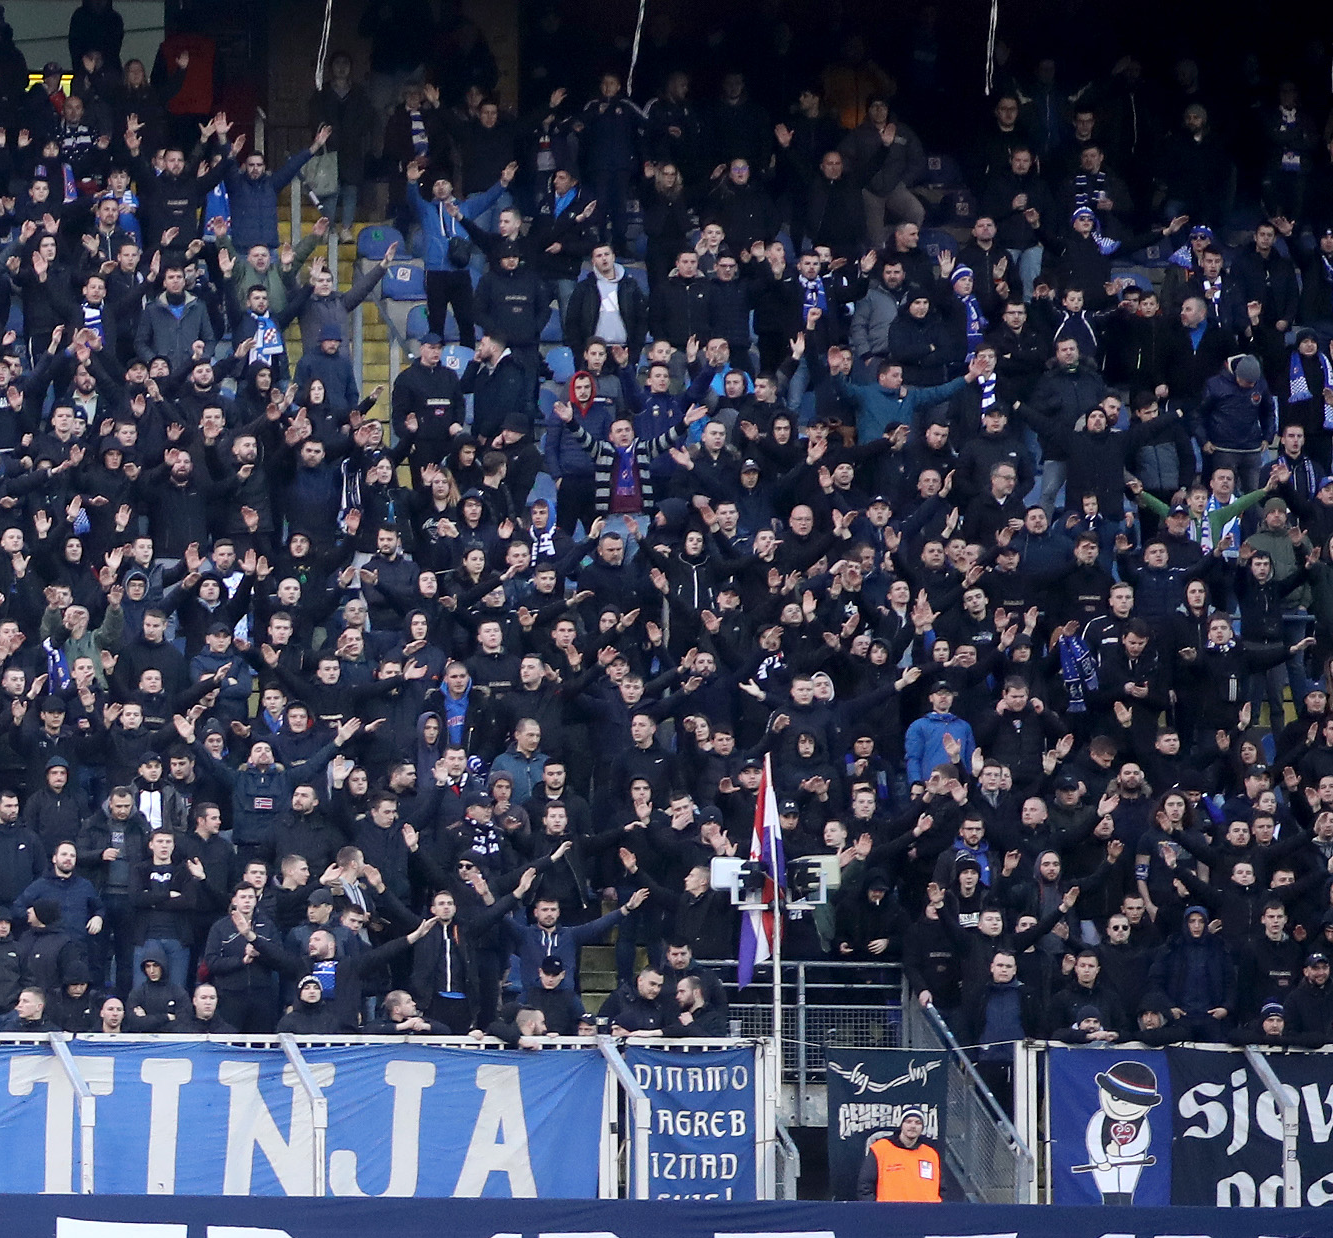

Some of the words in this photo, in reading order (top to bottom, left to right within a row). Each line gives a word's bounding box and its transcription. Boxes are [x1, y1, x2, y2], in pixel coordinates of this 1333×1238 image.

[633, 1063, 748, 1093] DINAMO
[648, 1109, 746, 1137] AGREB
[650, 1152, 738, 1180] IZNAD
